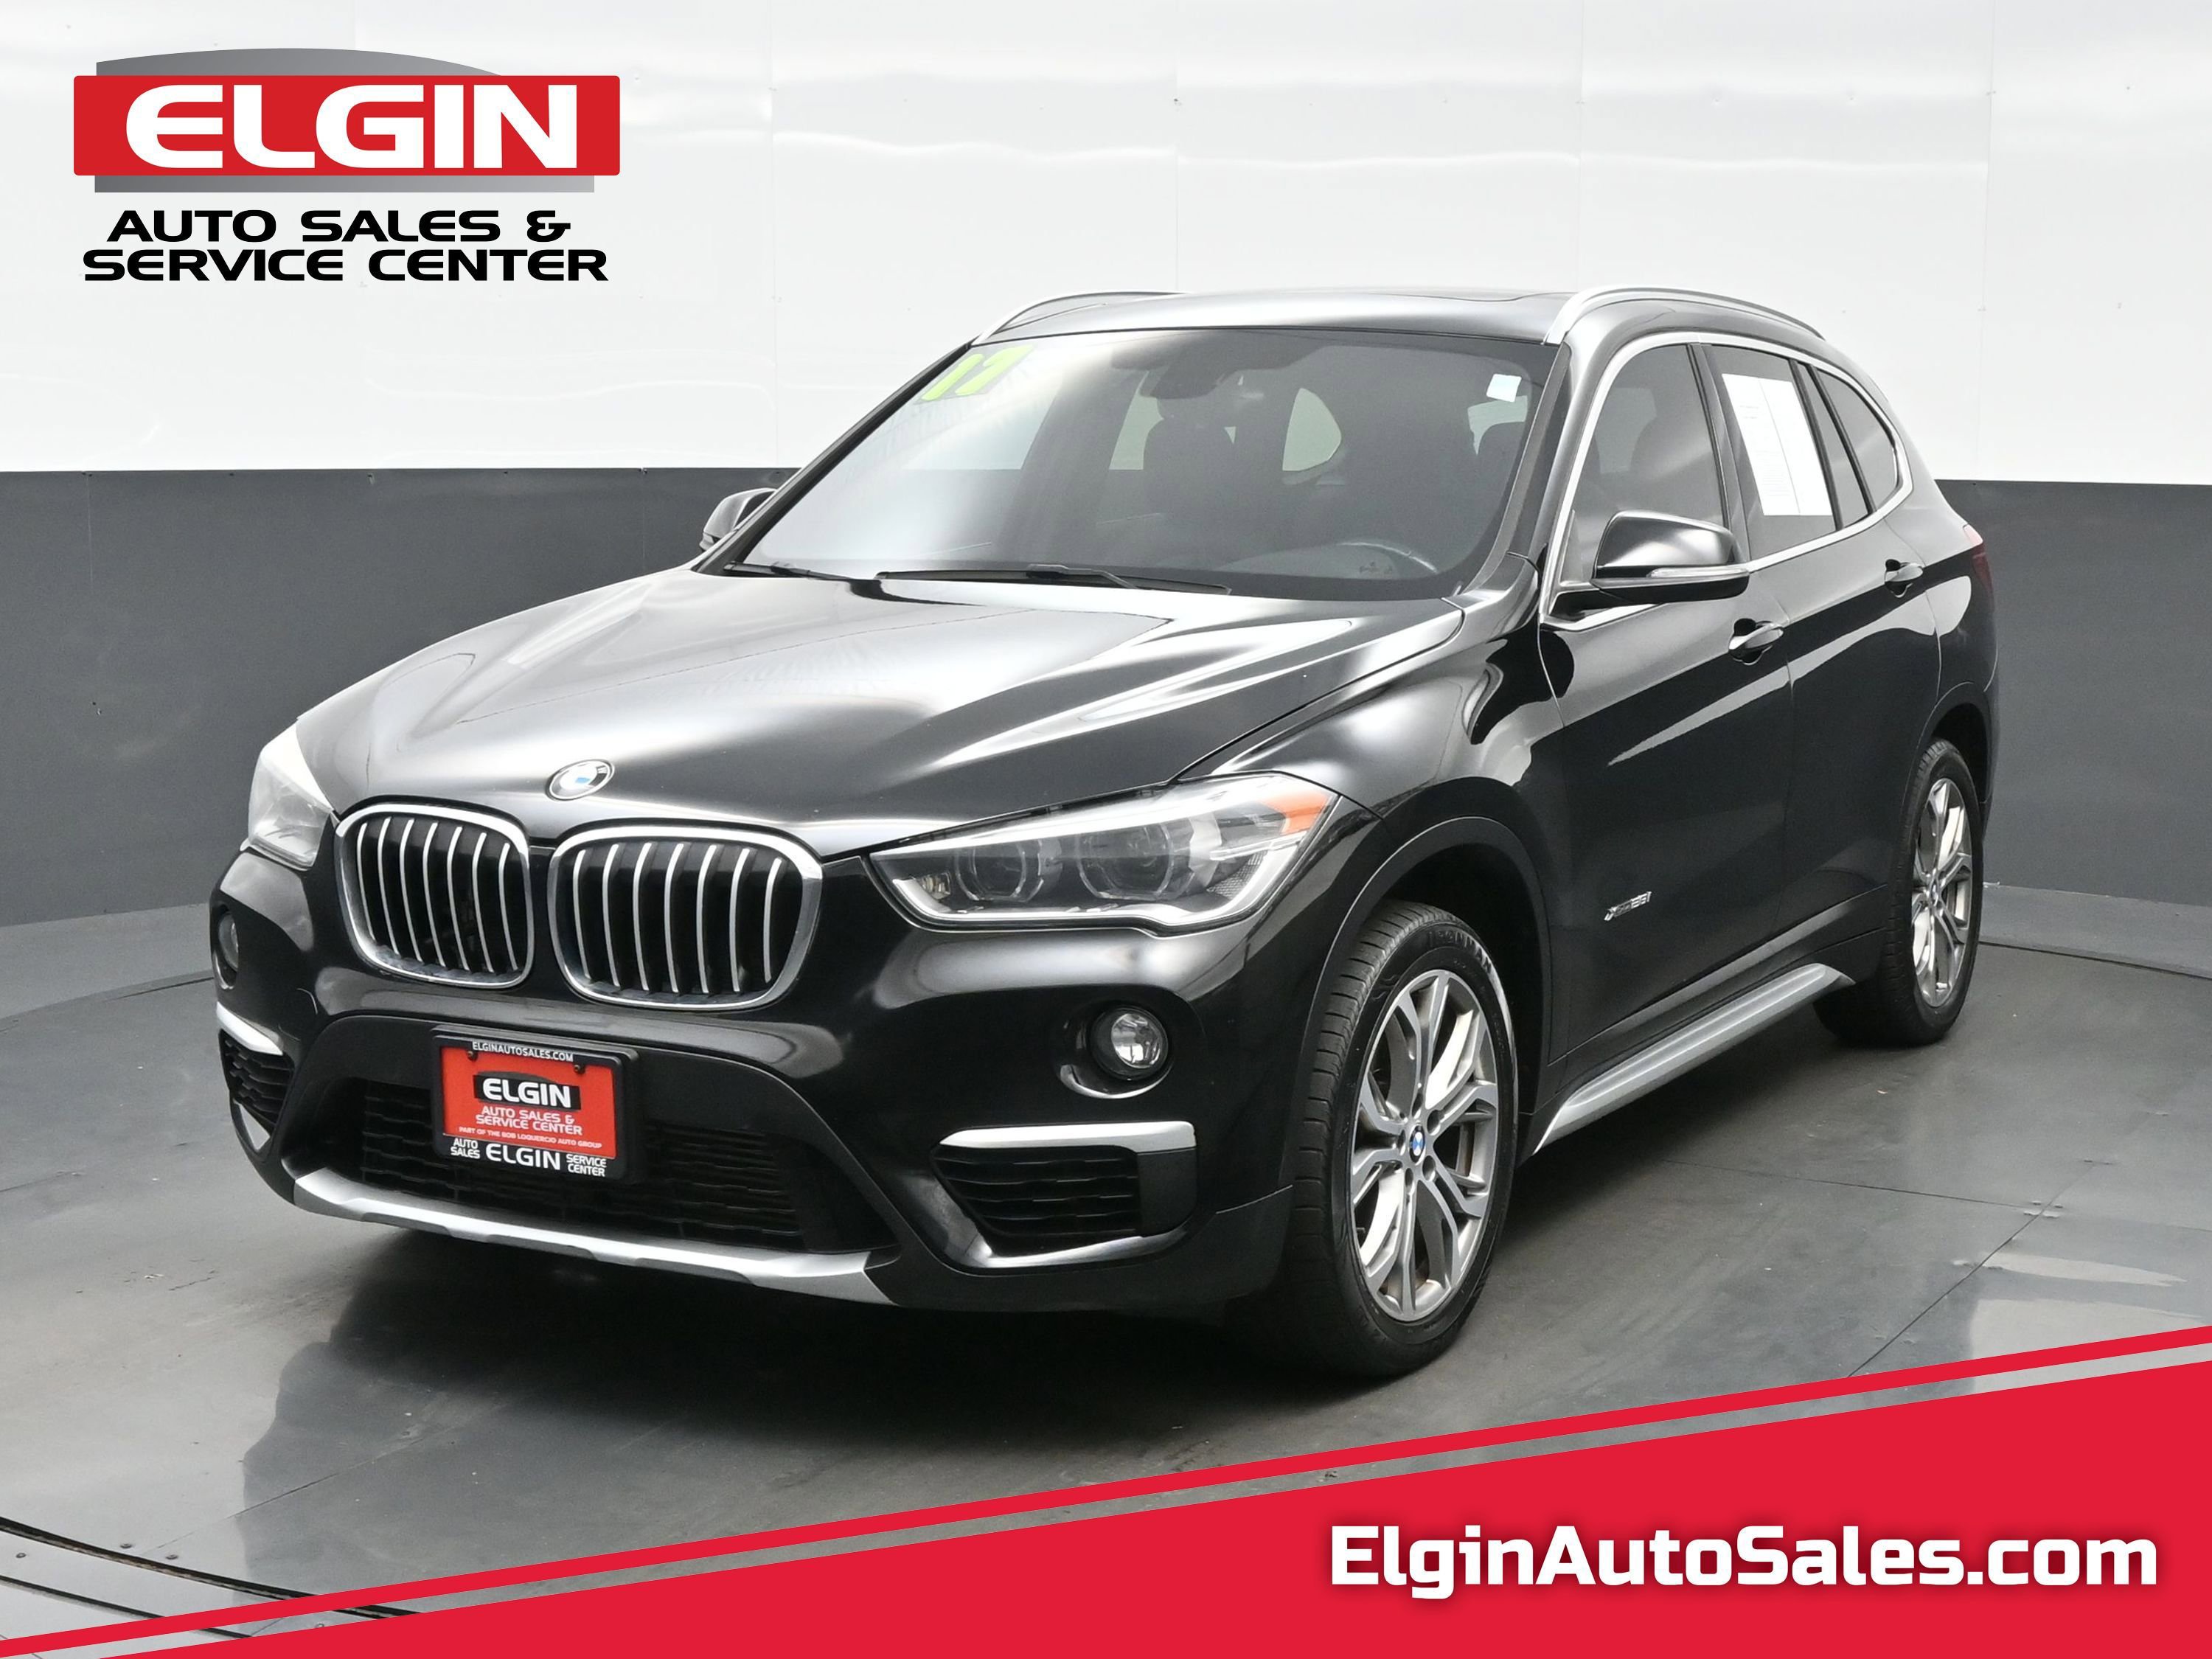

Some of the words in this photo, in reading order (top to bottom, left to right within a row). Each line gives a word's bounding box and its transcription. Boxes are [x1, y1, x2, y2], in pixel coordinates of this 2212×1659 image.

[921, 344, 1034, 401] 17
[472, 1041, 574, 1062] ELGINAUTOSALES.COM
[482, 1078, 571, 1107] ELGIN
[476, 1114, 529, 1130] SERVICE
[532, 1121, 582, 1135] CENTER
[481, 1105, 515, 1119] AUTO
[518, 1109, 560, 1121] SALES
[565, 1114, 574, 1124] &
[453, 1138, 478, 1150] AUTO
[459, 1126, 476, 1134] PART
[487, 1130, 501, 1138] THE
[501, 1131, 516, 1139] BOB
[557, 1138, 577, 1146] AUTO
[577, 1141, 602, 1149] GROUP
[451, 1146, 480, 1159] SALES
[485, 1144, 560, 1170] ELGIN
[566, 1153, 607, 1167] SERVICE
[568, 1163, 605, 1177] CENTER
